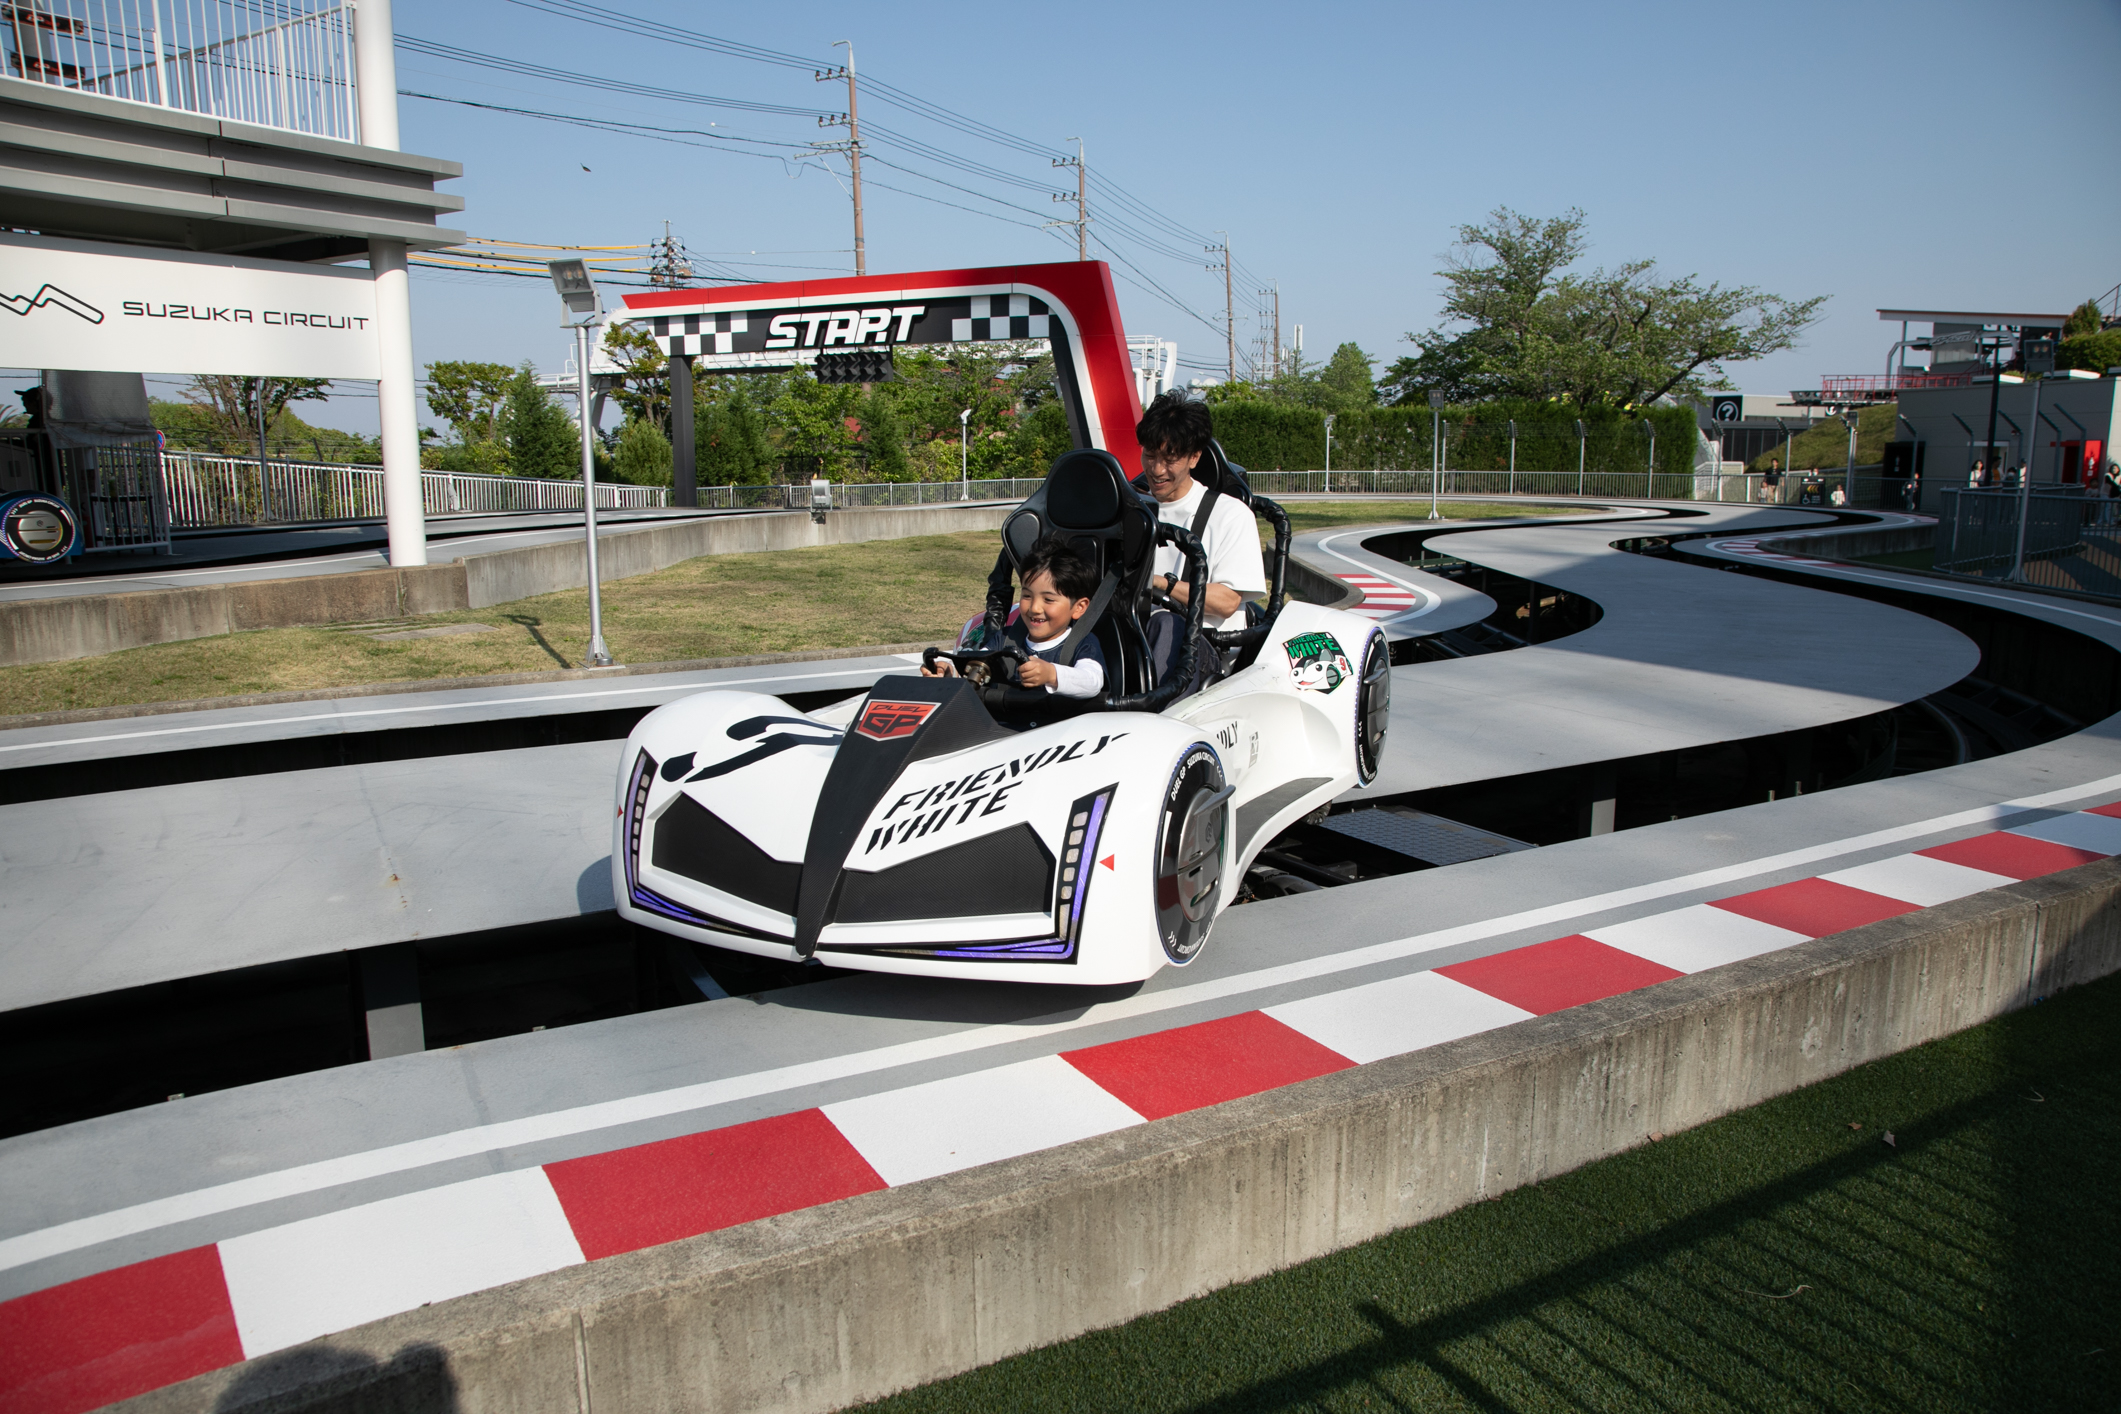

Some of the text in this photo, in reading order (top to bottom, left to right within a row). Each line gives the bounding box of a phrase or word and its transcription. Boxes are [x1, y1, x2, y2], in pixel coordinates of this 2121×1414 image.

[122, 301, 369, 330] SUZUKA CIRCUIT
[765, 306, 925, 348] START
[1288, 639, 1340, 659] WHITE
[1339, 657, 1347, 671] 9
[872, 704, 928, 713] DUEL
[862, 713, 924, 735] GP
[882, 732, 1131, 820] FRIENDLY
[1171, 777, 1182, 801] DUEL
[1180, 766, 1187, 780] GP
[865, 780, 1024, 855] WHITE
